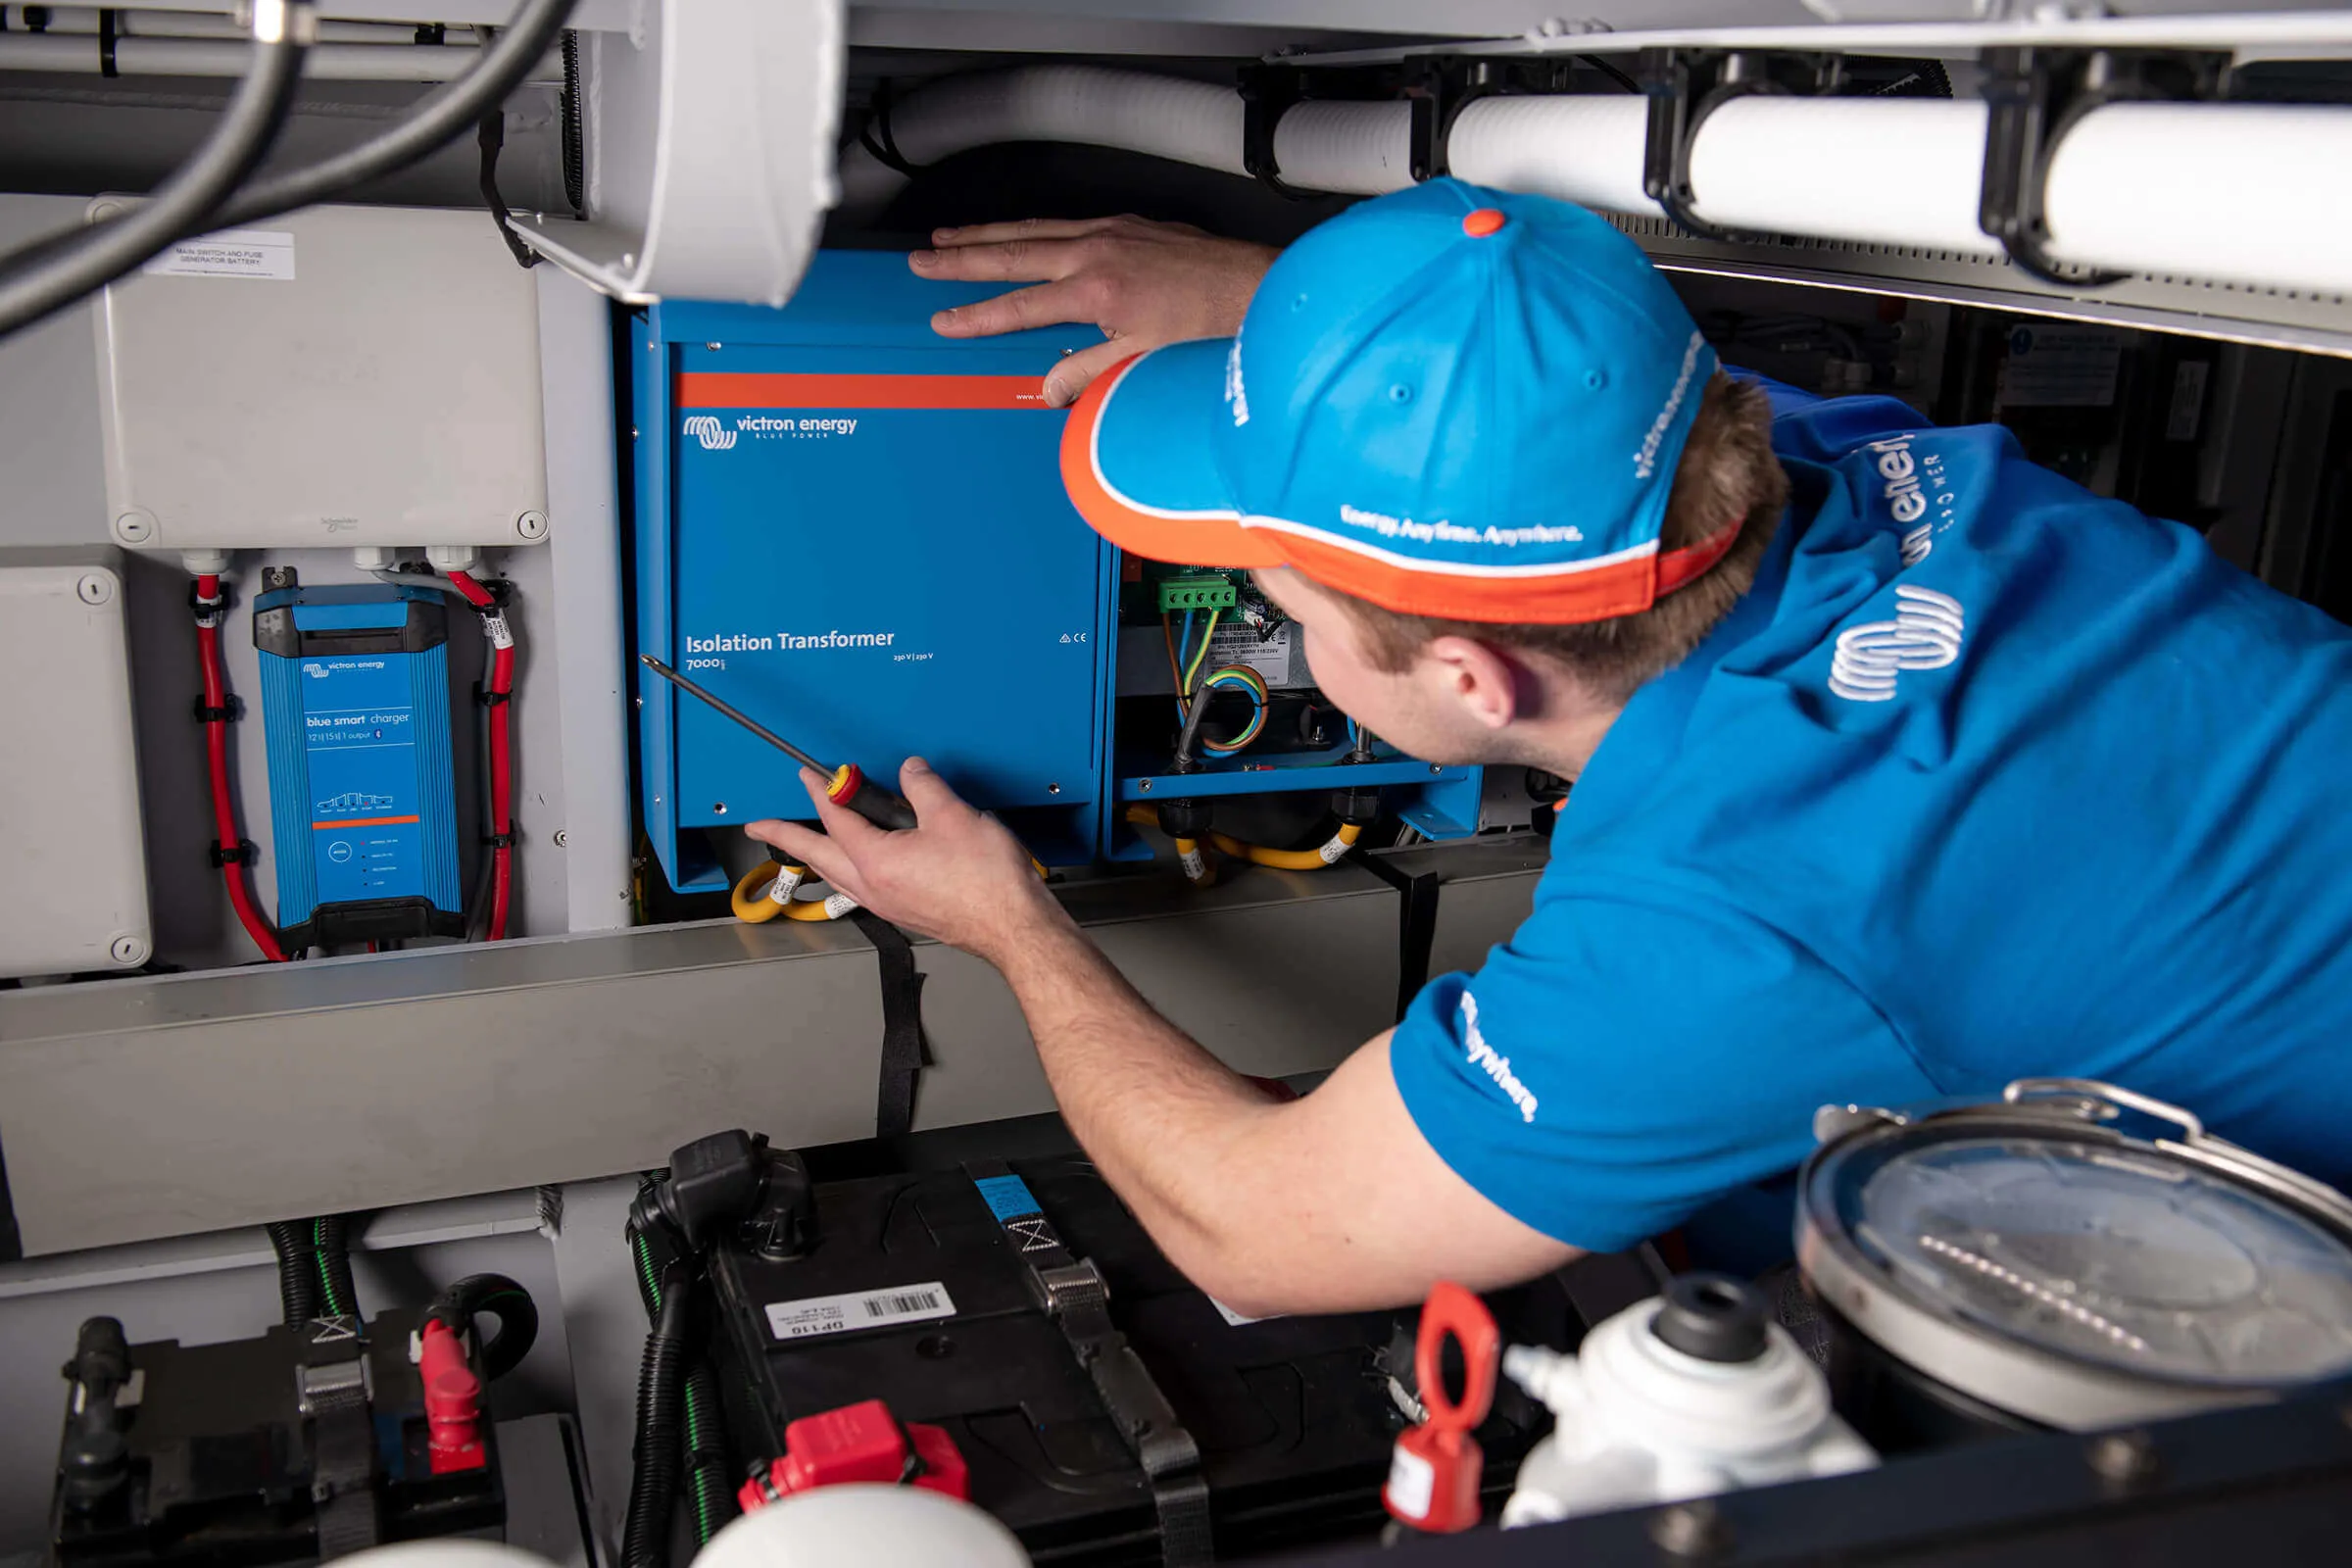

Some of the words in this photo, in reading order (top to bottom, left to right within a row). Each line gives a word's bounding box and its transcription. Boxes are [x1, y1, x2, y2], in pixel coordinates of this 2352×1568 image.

[180, 255, 226, 264] GENERATOR
[227, 257, 260, 266] BATTERY
[737, 416, 794, 431] victron
[799, 418, 858, 434] energy
[1867, 434, 1928, 522] ener
[687, 633, 772, 653] Isolation
[777, 630, 895, 650] Transformer
[358, 661, 385, 669] energy
[686, 659, 720, 671] 7000
[307, 717, 331, 727] blue
[334, 715, 366, 725] smart
[369, 713, 410, 725] charger
